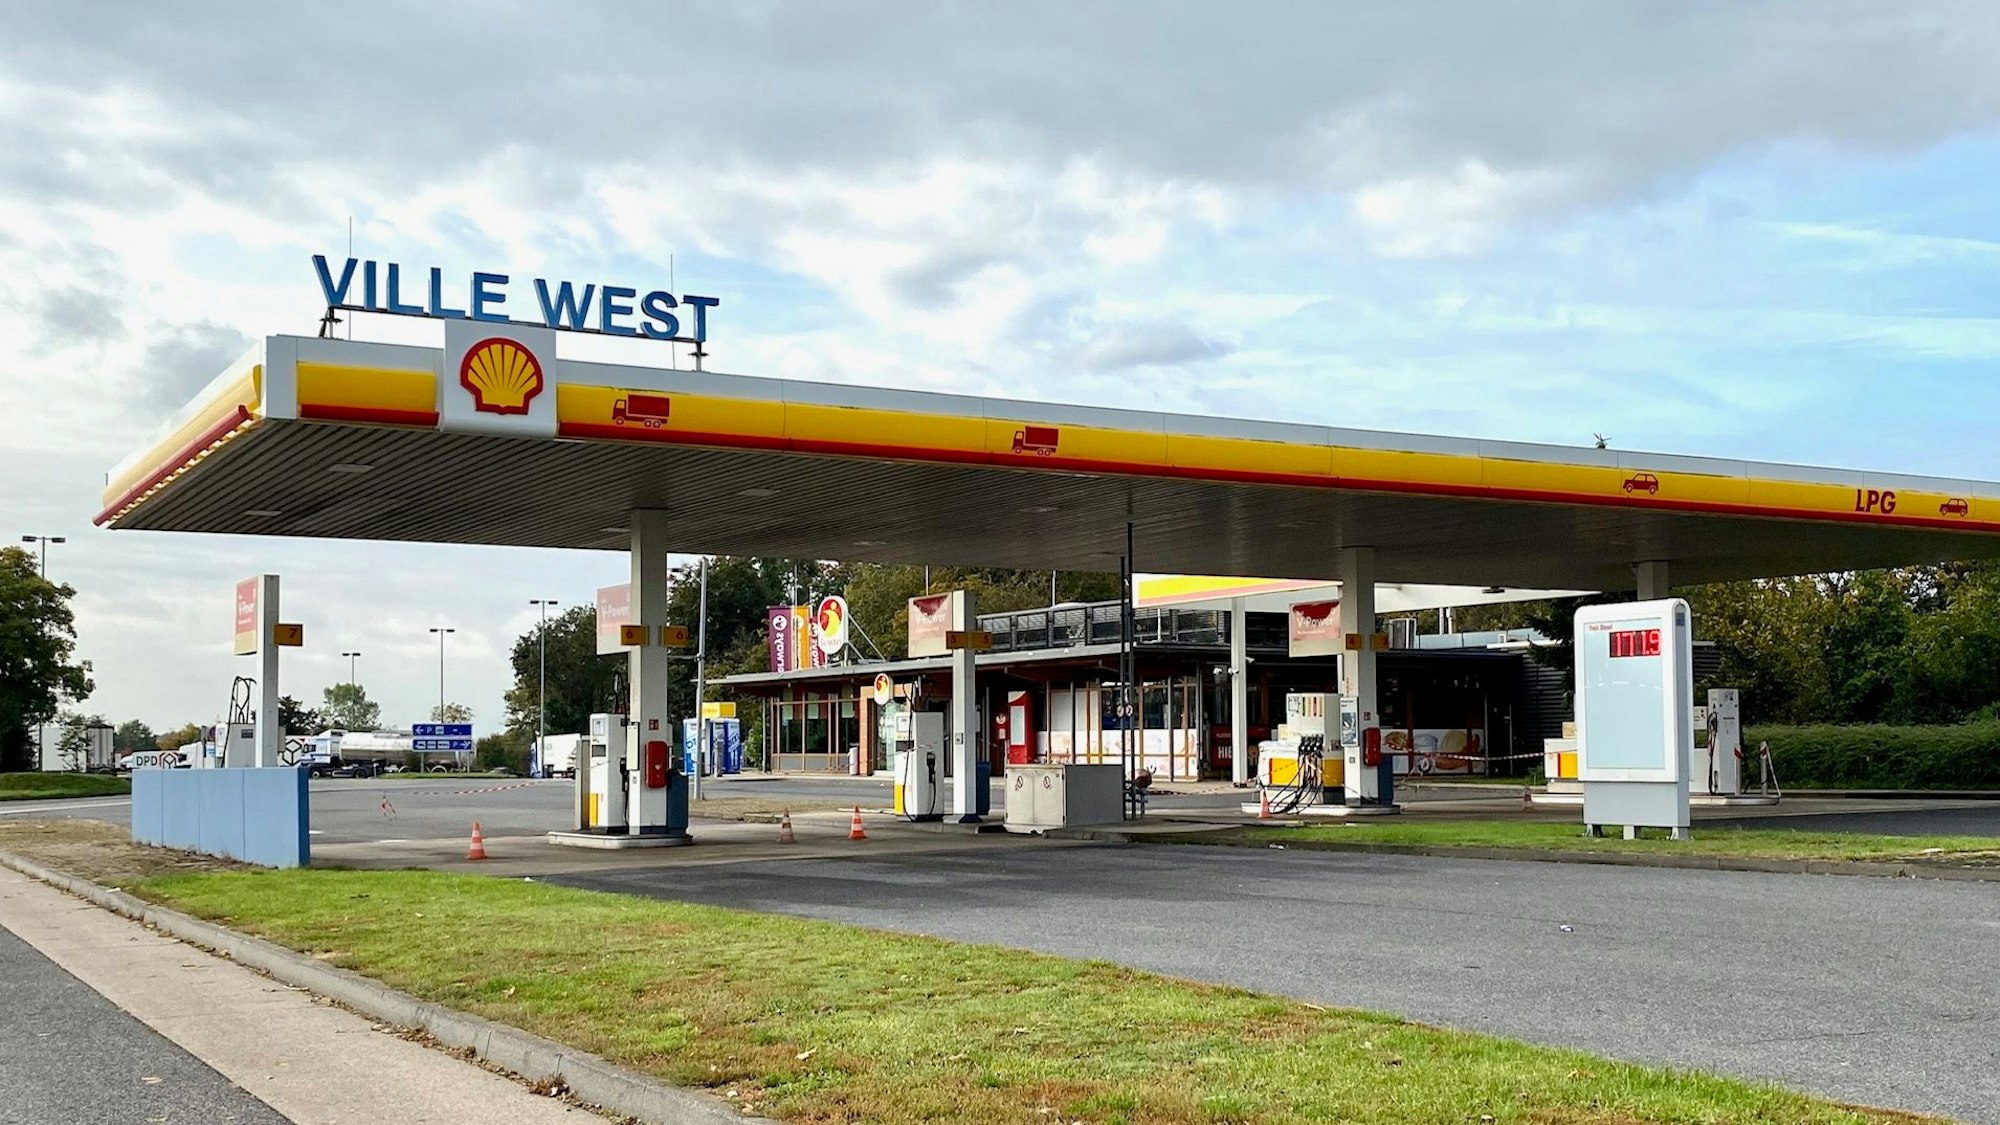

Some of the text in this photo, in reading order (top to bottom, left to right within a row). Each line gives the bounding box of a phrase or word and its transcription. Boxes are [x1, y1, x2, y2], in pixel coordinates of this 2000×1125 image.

[312, 255, 719, 343] VILLE WEST
[1855, 489, 1896, 514] LPG
[1296, 616, 1334, 628] V-Power
[289, 628, 297, 638] 7
[626, 629, 633, 639] 6
[676, 630, 683, 639] 6
[136, 755, 158, 767] DPD
